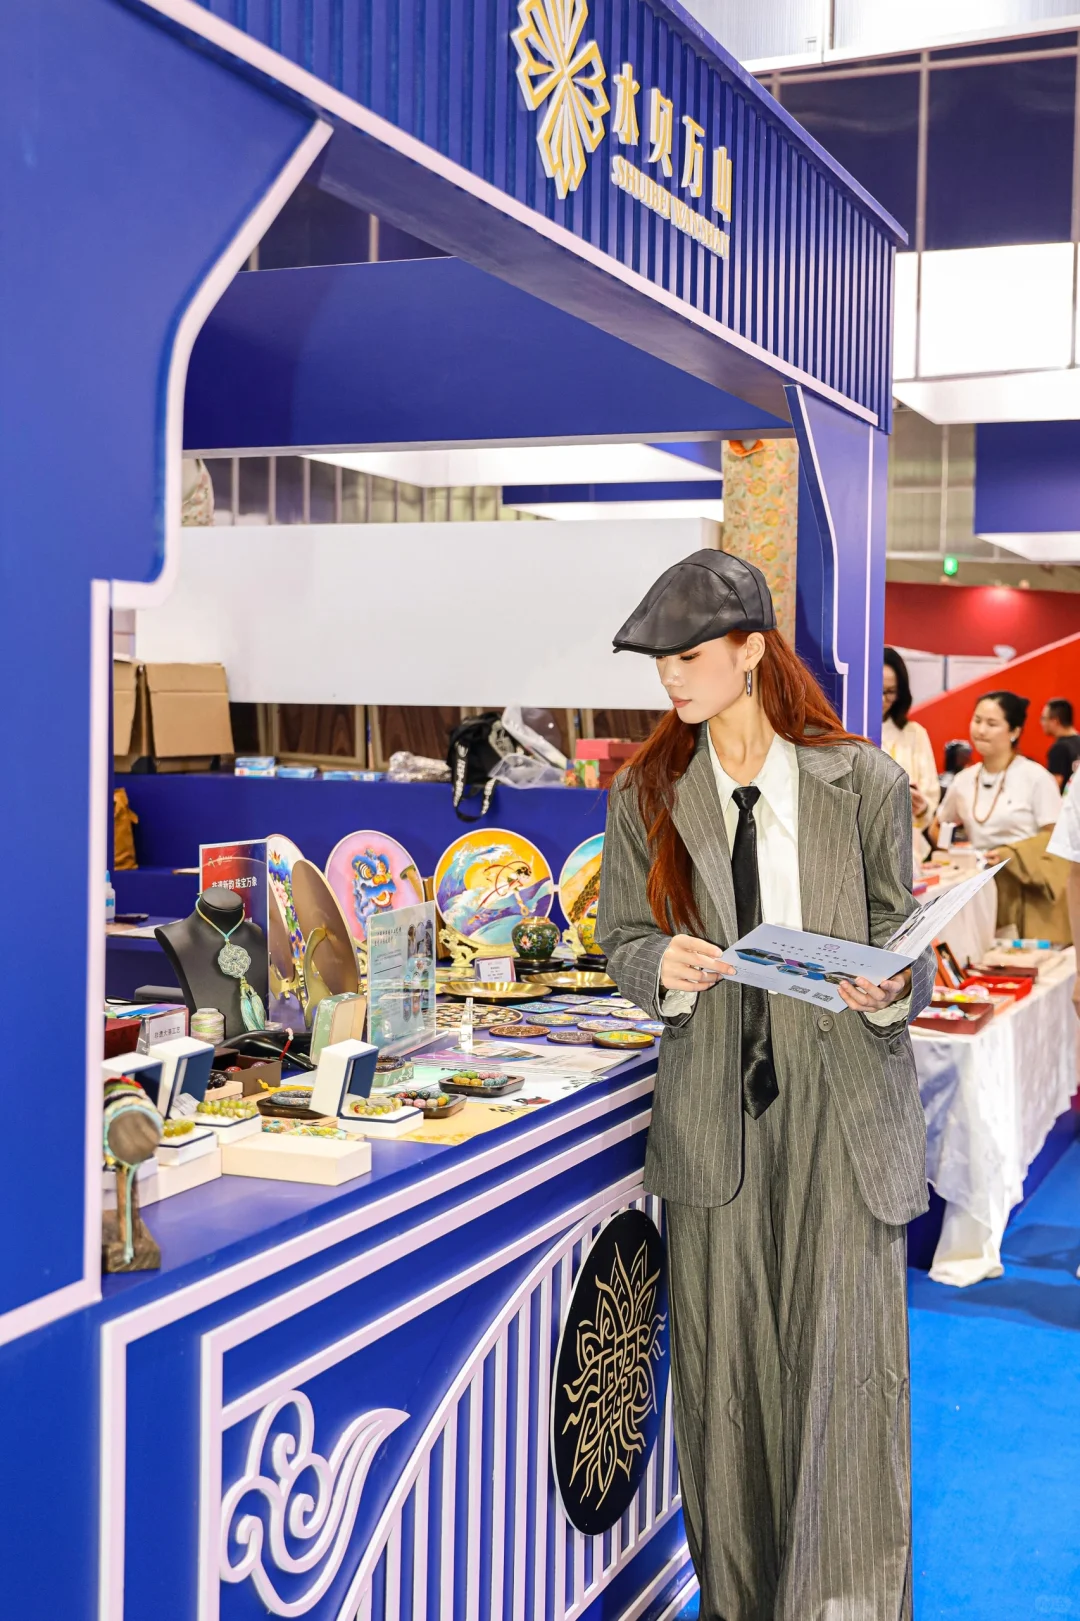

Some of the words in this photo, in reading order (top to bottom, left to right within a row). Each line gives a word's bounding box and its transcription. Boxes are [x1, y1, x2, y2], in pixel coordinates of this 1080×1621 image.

[611, 154, 671, 219] SHUIBEI
[670, 196, 730, 260] WANSHAN
[612, 62, 732, 222] 水贝万山
